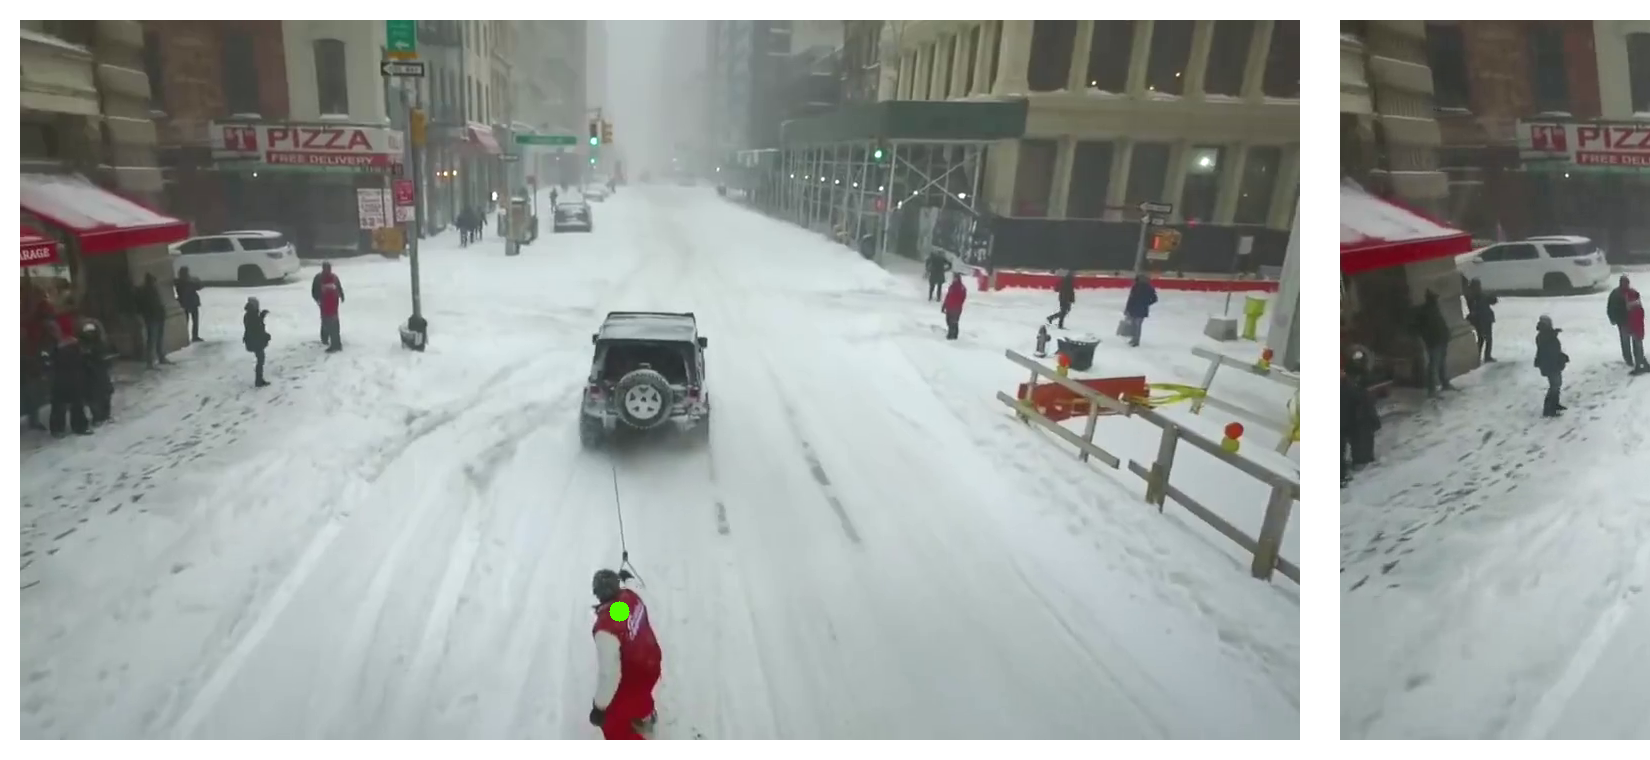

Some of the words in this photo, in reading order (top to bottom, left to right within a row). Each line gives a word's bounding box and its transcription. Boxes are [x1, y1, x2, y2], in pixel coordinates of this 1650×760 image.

[267, 128, 373, 150] PIZZA
[271, 154, 306, 164] FREE
[309, 155, 374, 165] DELIVERY
[1581, 154, 1618, 164] FREE
